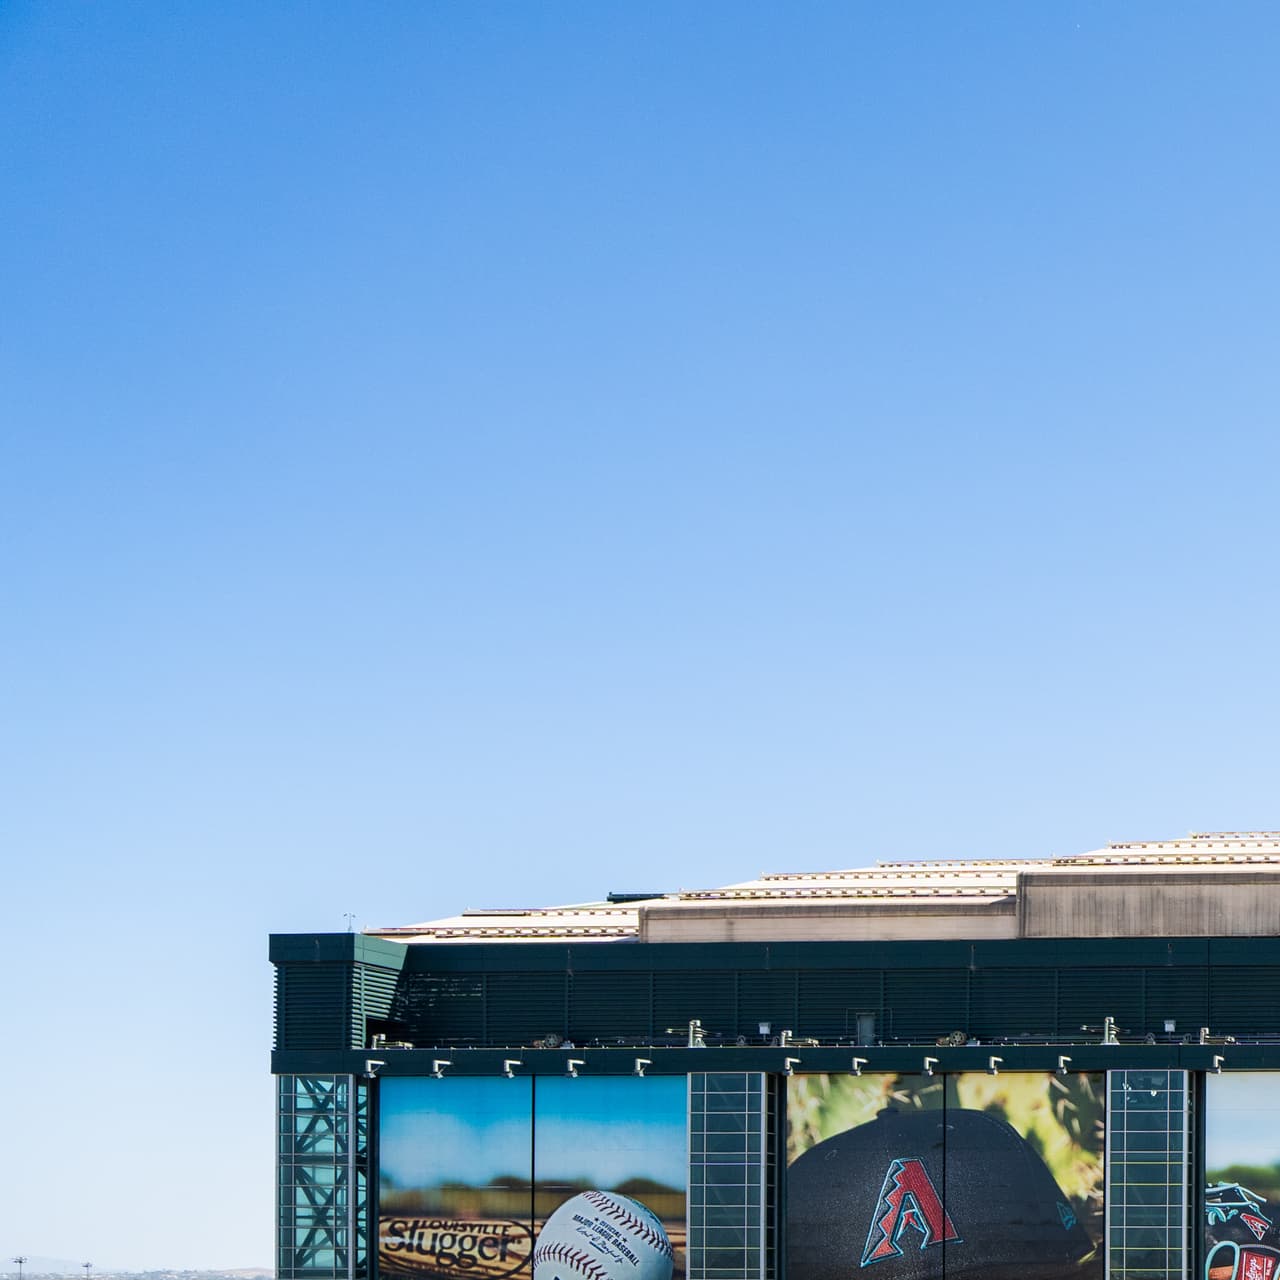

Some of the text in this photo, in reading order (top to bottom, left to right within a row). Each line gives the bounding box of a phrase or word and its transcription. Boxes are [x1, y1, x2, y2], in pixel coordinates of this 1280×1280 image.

[384, 1220, 512, 1268] Slugger
[417, 1219, 512, 1236] LOUISVILLE
[572, 1214, 594, 1227] MAJOR
[592, 1224, 614, 1241] LEAGUE
[611, 1238, 640, 1266] BASEBALL
